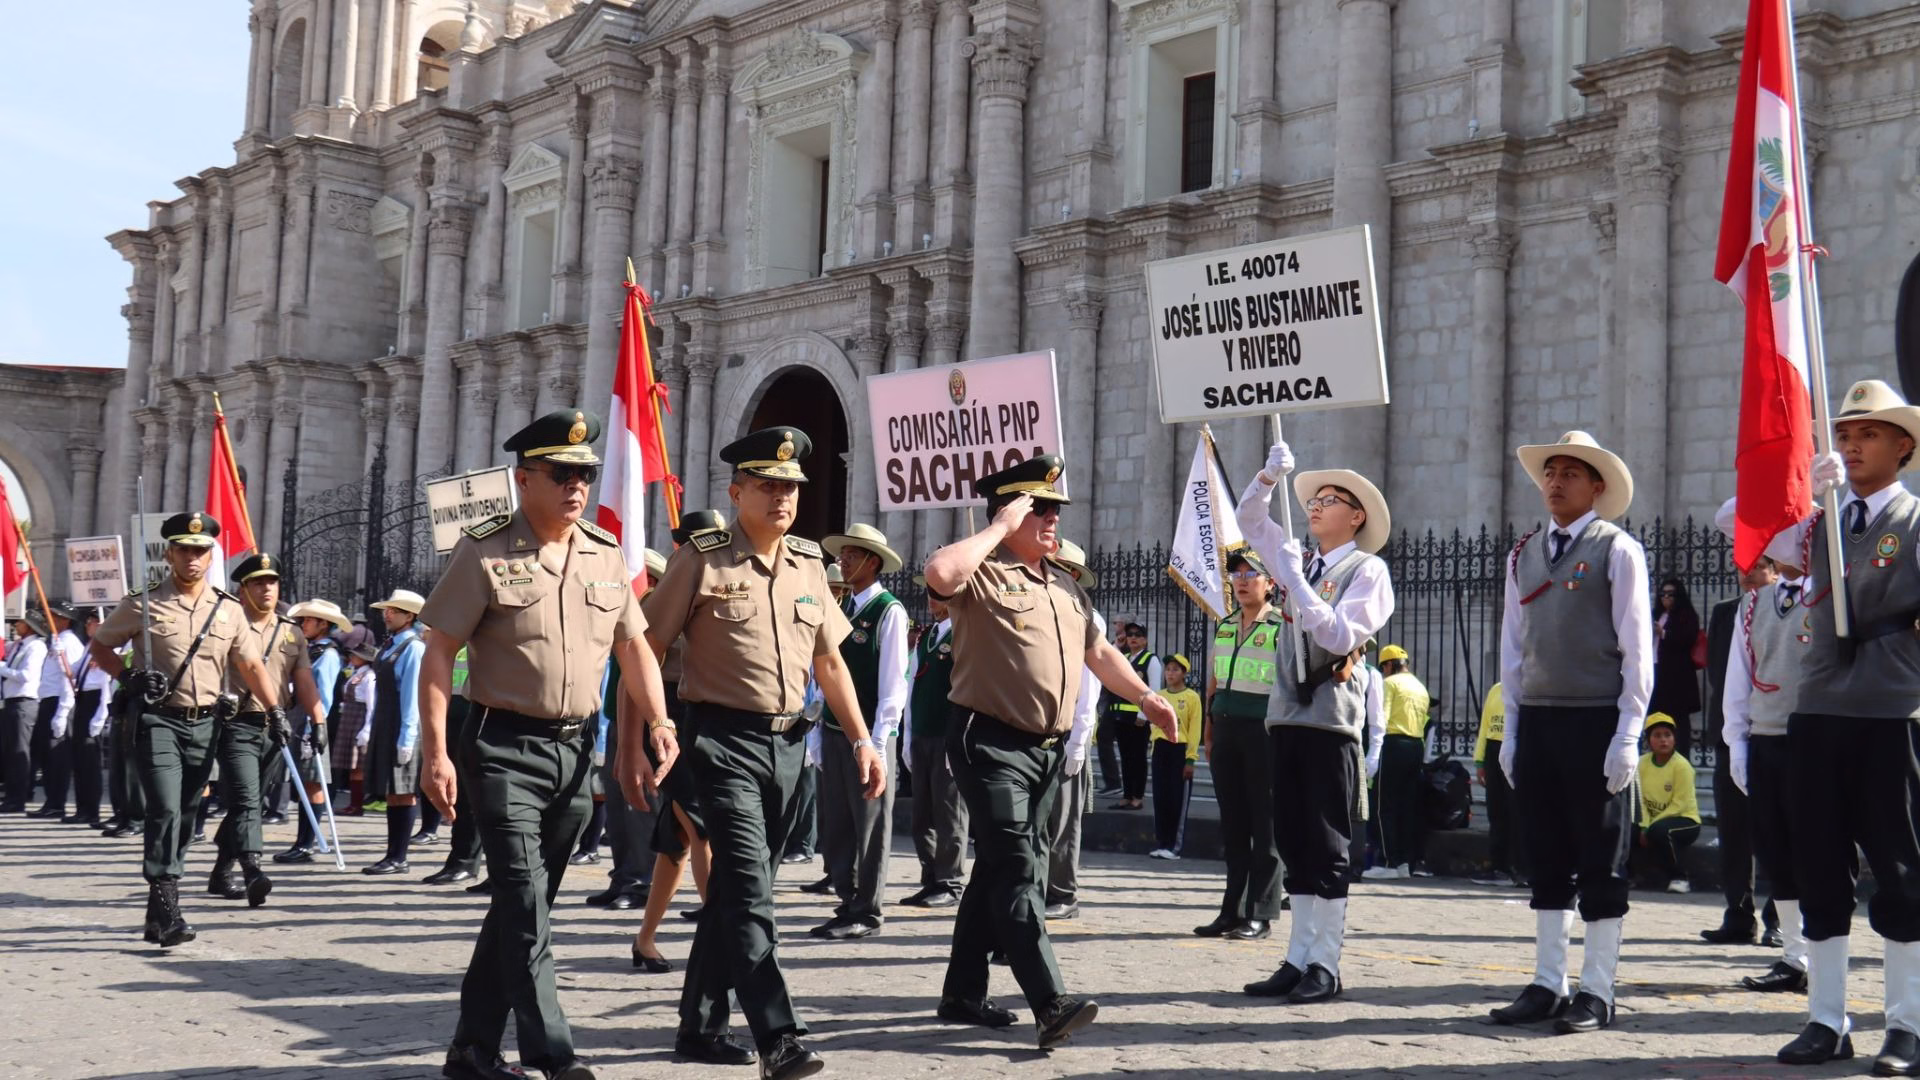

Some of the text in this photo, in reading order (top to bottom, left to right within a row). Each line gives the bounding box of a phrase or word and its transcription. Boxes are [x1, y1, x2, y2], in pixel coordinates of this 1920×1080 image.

[1206, 251, 1299, 286] I.E. 40074
[1162, 280, 1363, 340] JOSÉ LUIS BUSTAMANTE
[1222, 331, 1301, 372] Y RIVERO
[1203, 376, 1332, 409] SACHACA
[888, 399, 1040, 453] COMISARÍA PNP
[886, 446, 1046, 504] SACHA
[433, 496, 509, 525] DIVINA PROVIDENCIA
[1192, 481, 1216, 571] POLICIA ESCOLAR
[1186, 570, 1208, 594] CIRCA
